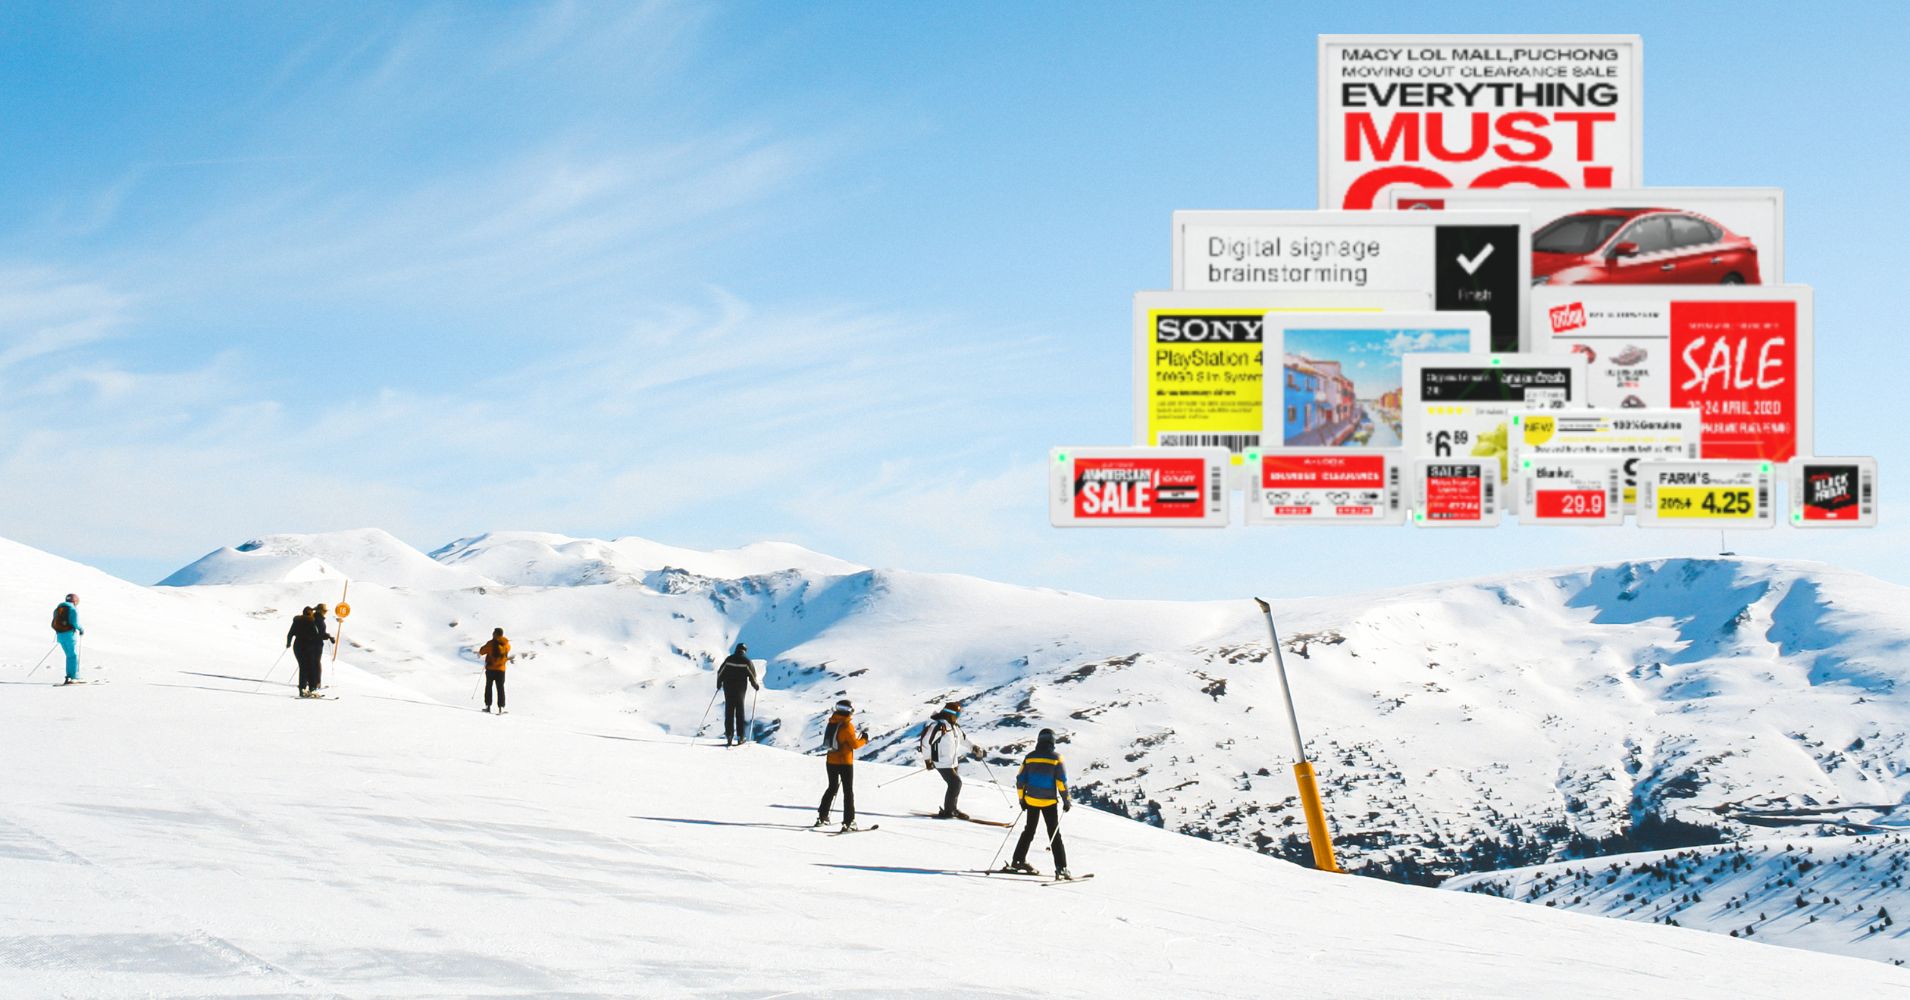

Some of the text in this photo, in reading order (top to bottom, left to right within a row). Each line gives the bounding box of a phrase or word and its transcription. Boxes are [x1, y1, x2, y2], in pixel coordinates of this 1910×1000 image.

[1342, 49, 1402, 60] MACY
[1407, 49, 1447, 60] LOL
[1342, 66, 1617, 77] MOVING OUT CLEARANCE SALE
[1342, 83, 1618, 107] EVERYTHING
[1344, 111, 1616, 162] MUST
[1208, 237, 1380, 261] Digital signage
[1208, 264, 1368, 286] brainstorming
[1158, 319, 1263, 341] SONY
[1156, 350, 1263, 369] PlayStation 4
[1681, 336, 1786, 394] SALE
[1721, 400, 1752, 415] APRIL
[1753, 400, 1781, 415] 2020
[1659, 472, 1711, 485] FARM'S
[1082, 481, 1152, 514] SALE
[1561, 494, 1602, 514] 29.9
[1701, 491, 1751, 514] 4.25
